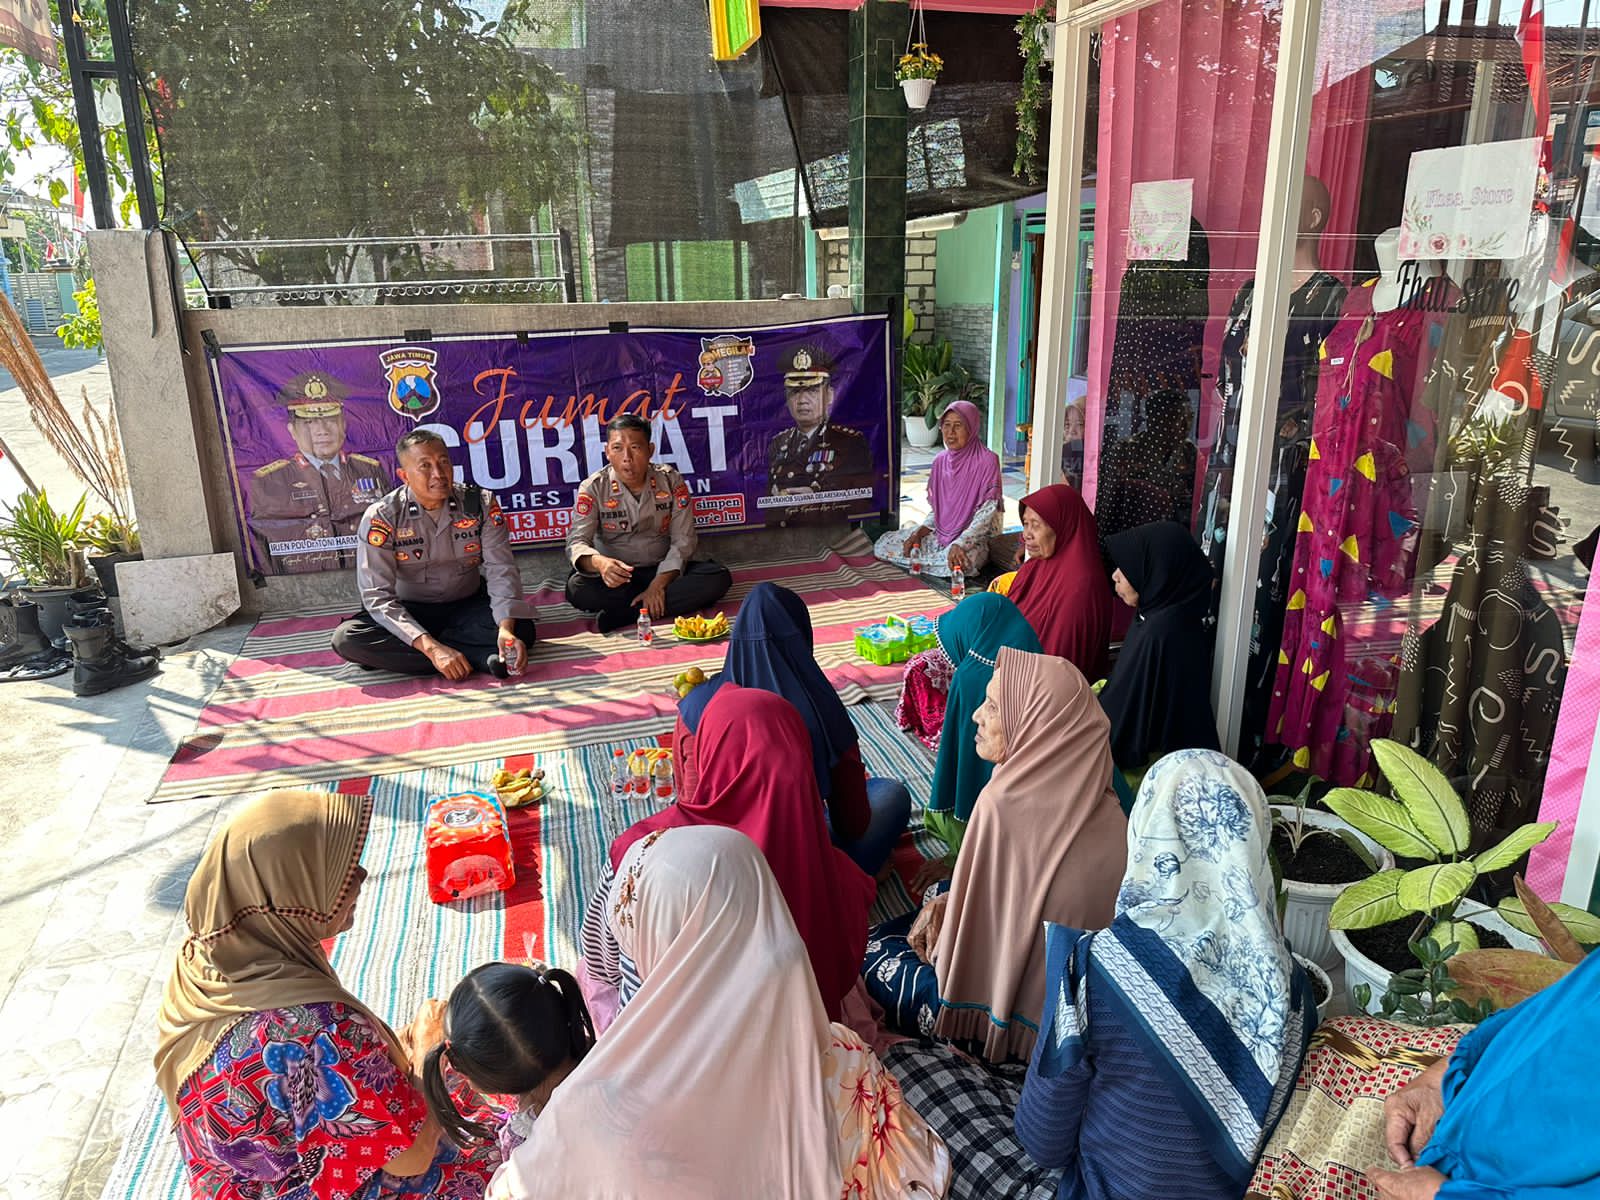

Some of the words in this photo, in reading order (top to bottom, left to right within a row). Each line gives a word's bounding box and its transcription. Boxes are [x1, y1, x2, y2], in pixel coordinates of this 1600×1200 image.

[386, 352, 407, 362] JAWA
[408, 352, 431, 360] TIMUR
[696, 498, 741, 511] simpen
[723, 511, 742, 521] lur
